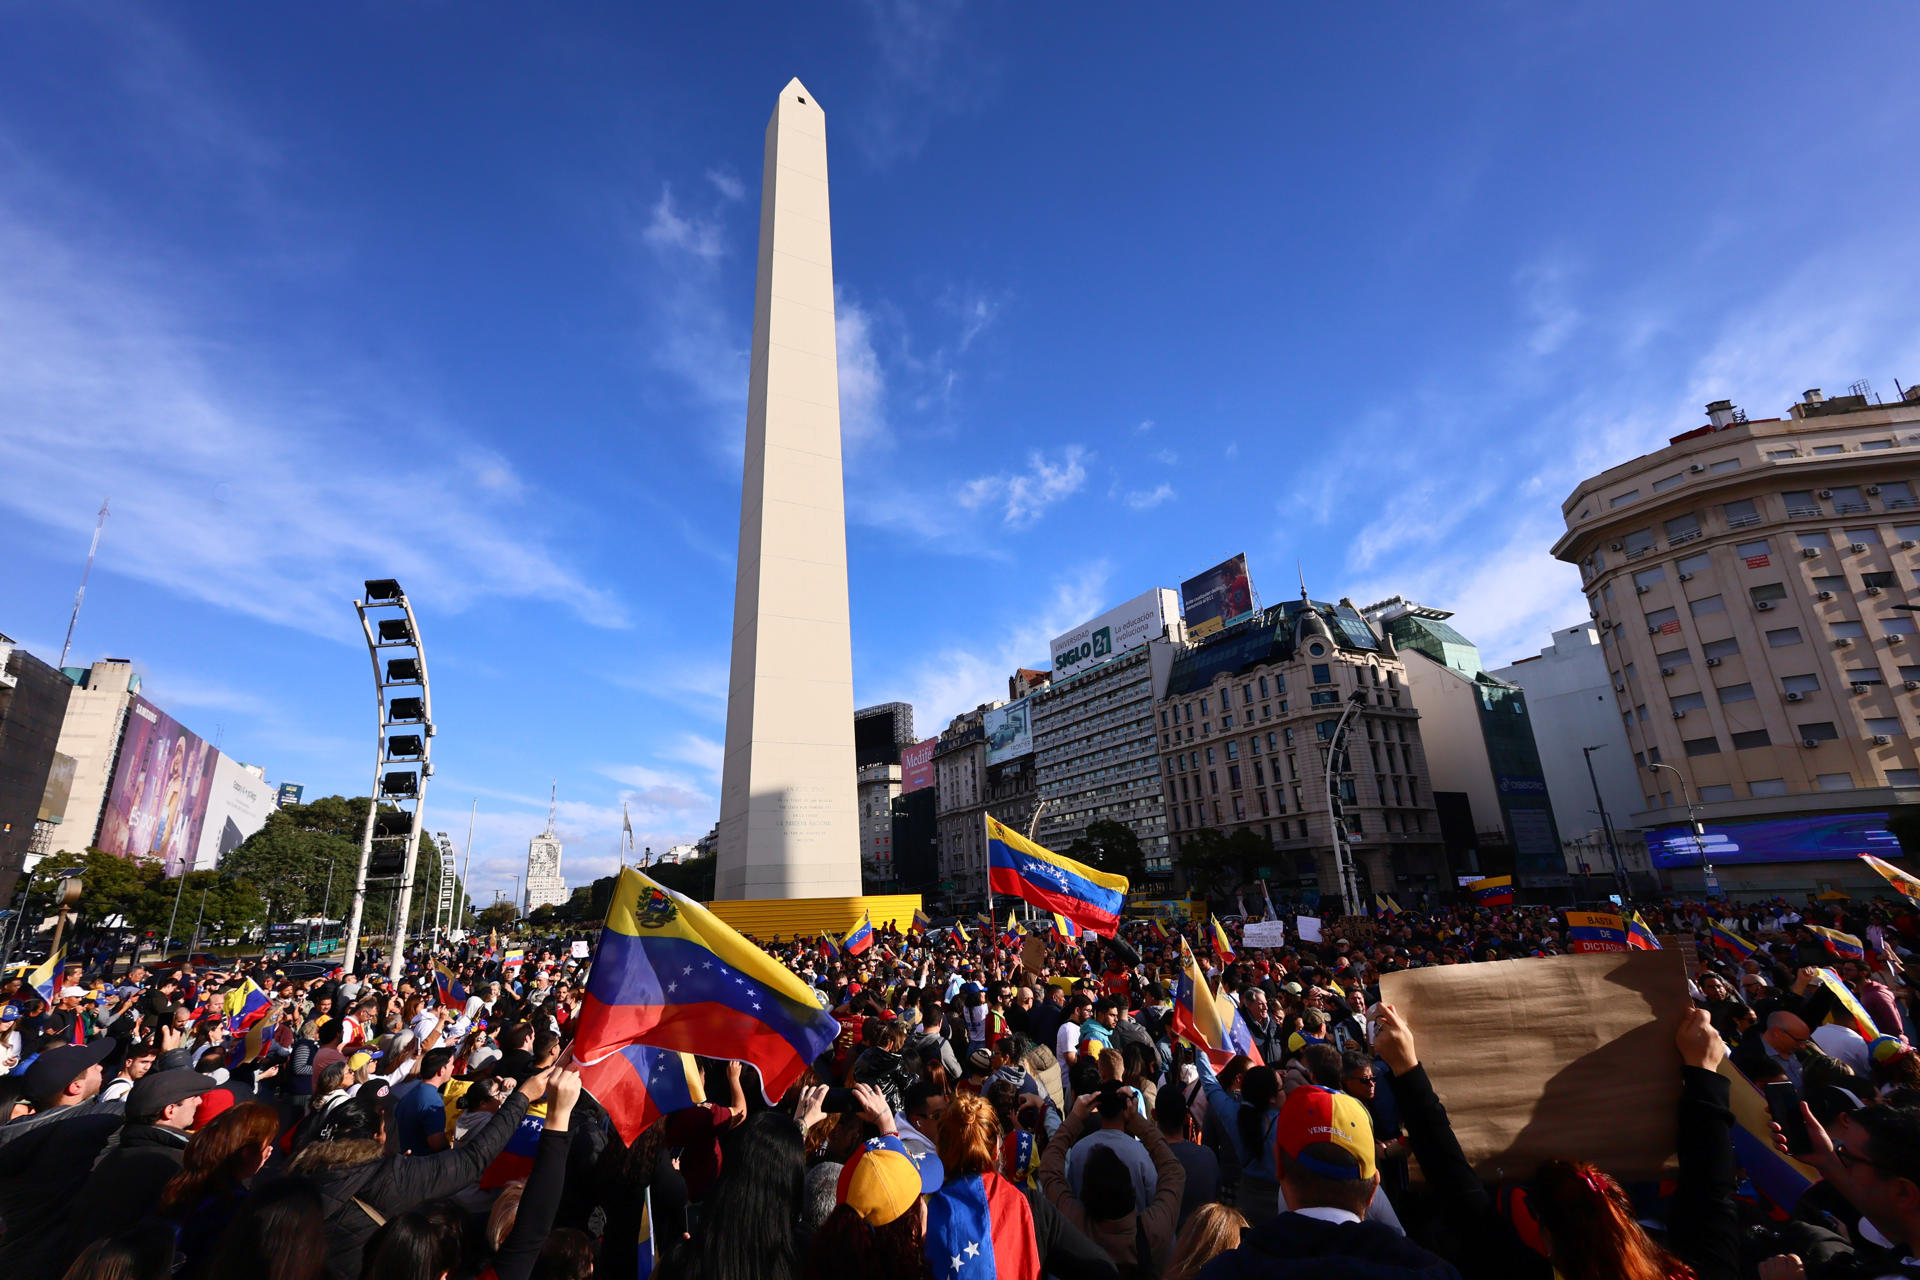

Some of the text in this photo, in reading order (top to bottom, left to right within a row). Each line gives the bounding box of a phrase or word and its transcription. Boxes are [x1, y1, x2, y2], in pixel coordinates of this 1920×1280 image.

[1114, 611, 1154, 634] La educación
[1116, 623, 1149, 643] evoluciona
[1055, 630, 1090, 652] UNIVERSIDAD
[1056, 634, 1107, 671] SIGLO 21
[136, 703, 157, 724] SAMSUNG
[905, 747, 932, 770] Medifé
[1587, 917, 1612, 925] BASTA
[1600, 930, 1612, 938] DE
[1308, 1126, 1352, 1143] VENEZUELA
